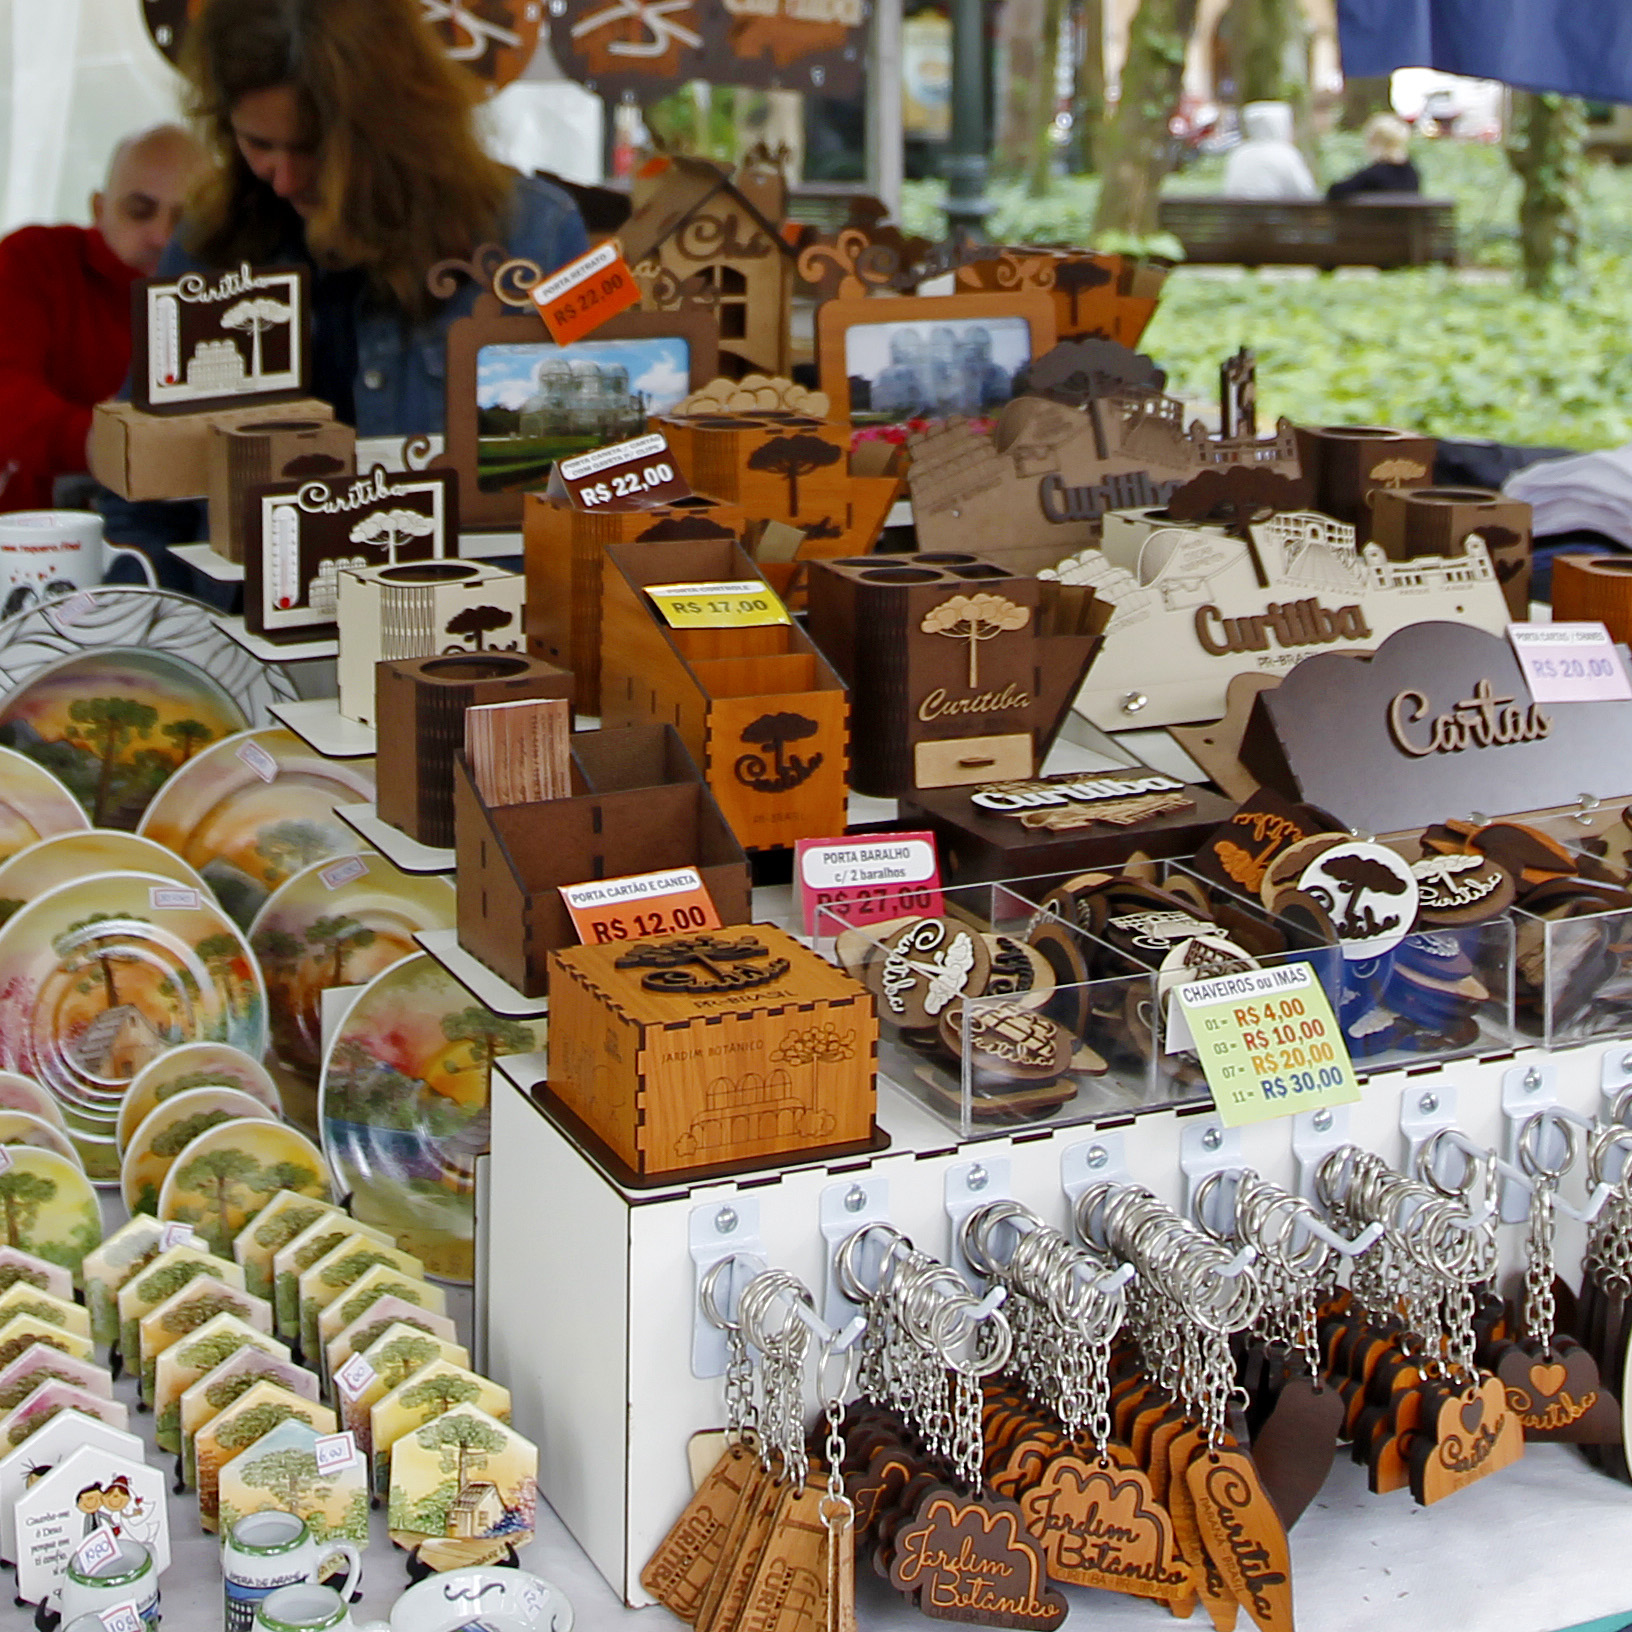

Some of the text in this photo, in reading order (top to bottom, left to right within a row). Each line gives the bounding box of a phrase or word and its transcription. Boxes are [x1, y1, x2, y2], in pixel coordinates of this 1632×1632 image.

[176, 262, 271, 304] Curitiba
[552, 273, 625, 327] R$ 22,00
[296, 469, 408, 515] Curitiba
[579, 462, 674, 508] R$ 22,00
[671, 598, 768, 616] R$ 17,00
[1194, 597, 1373, 657] Curitiba
[1561, 658, 1615, 679] 20,00
[919, 682, 1032, 722] Curitiba
[1387, 678, 1555, 759] Cartas
[971, 776, 1186, 811] Curitiba
[822, 846, 911, 865] PORTA BARALHO
[849, 868, 858, 881] 2
[859, 865, 906, 880] baralhos
[571, 874, 698, 904] PORTA CARTÃO E CANETA
[816, 885, 933, 918] R$ 27,00
[591, 905, 707, 943] R$ 12,00
[694, 988, 800, 1009] PR-BRASIL
[1182, 967, 1308, 1004] CHAVEIROS ou IMÃS
[1232, 997, 1306, 1028] R$ 4,00
[1241, 1018, 1326, 1052] R$ 10,00
[660, 1047, 704, 1065] JARDIM
[1250, 1041, 1335, 1076] R$ 20,00
[1260, 1065, 1344, 1101] R$ 30,00
[1503, 1385, 1598, 1430] Curitiba
[1026, 1487, 1141, 1543] Jardim
[644, 1504, 716, 1591] CURITIBA
[899, 1523, 1014, 1583] Jardim
[1205, 1466, 1288, 1623] Curitiba
